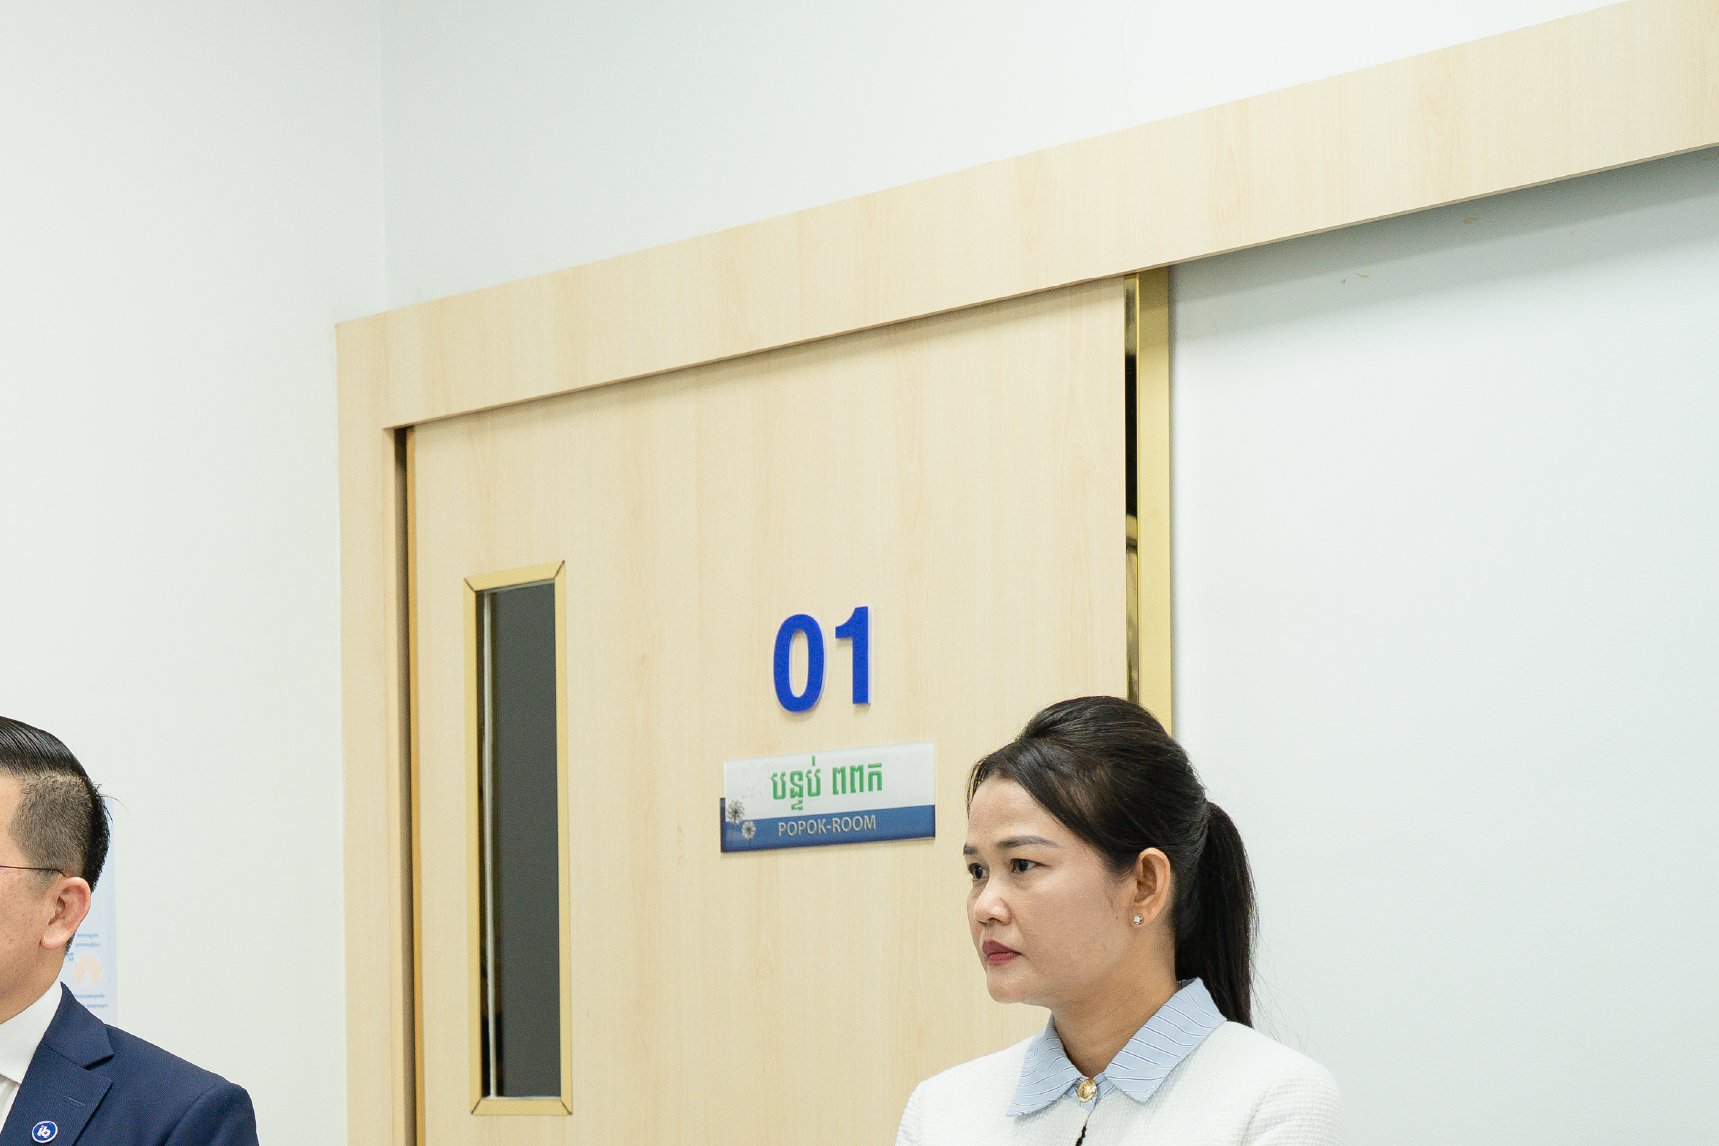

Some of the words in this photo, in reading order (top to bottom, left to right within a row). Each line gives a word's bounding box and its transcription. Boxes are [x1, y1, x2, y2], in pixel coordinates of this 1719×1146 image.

[773, 605, 871, 713] 01
[832, 762, 883, 796] ពពក
[778, 814, 877, 837] POPOK-ROOM
